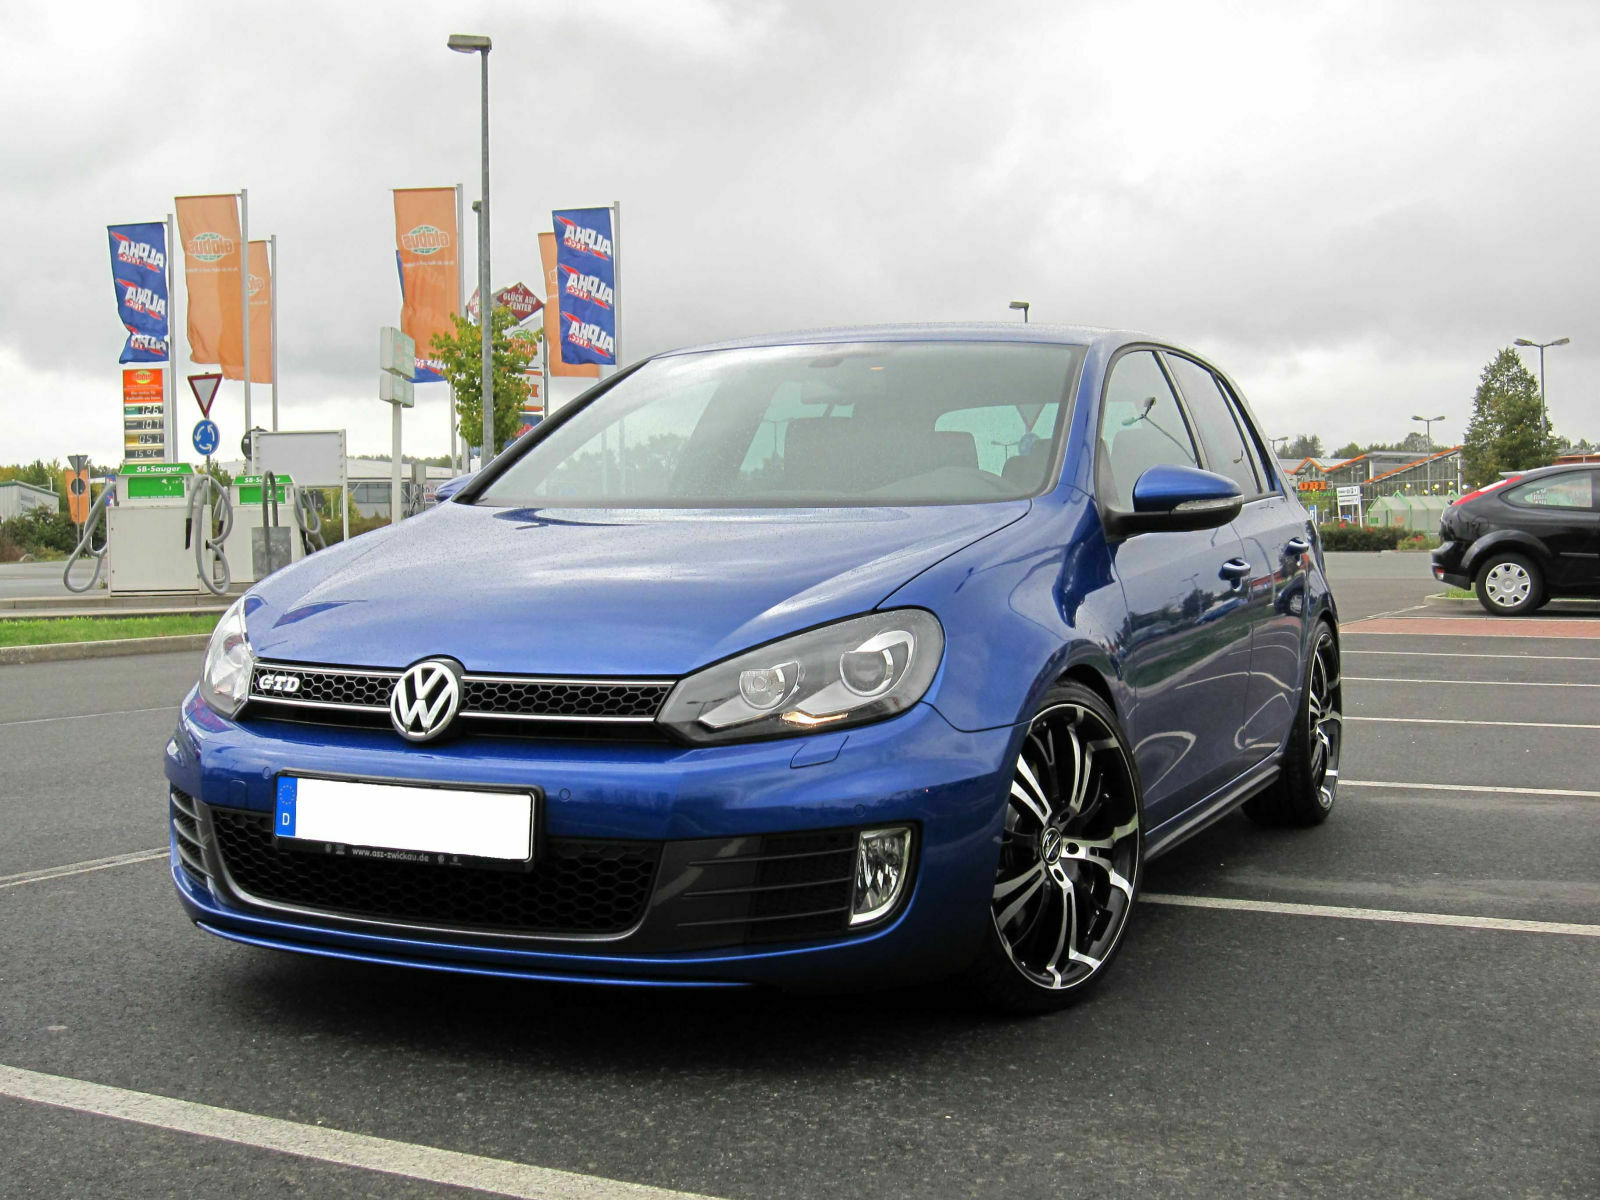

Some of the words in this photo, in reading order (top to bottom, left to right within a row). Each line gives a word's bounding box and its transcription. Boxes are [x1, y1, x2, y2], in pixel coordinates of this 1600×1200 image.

[502, 291, 523, 303] GLÜCK
[136, 465, 181, 474] SB-Sauger
[259, 675, 300, 692] GTD
[281, 812, 290, 826] D
